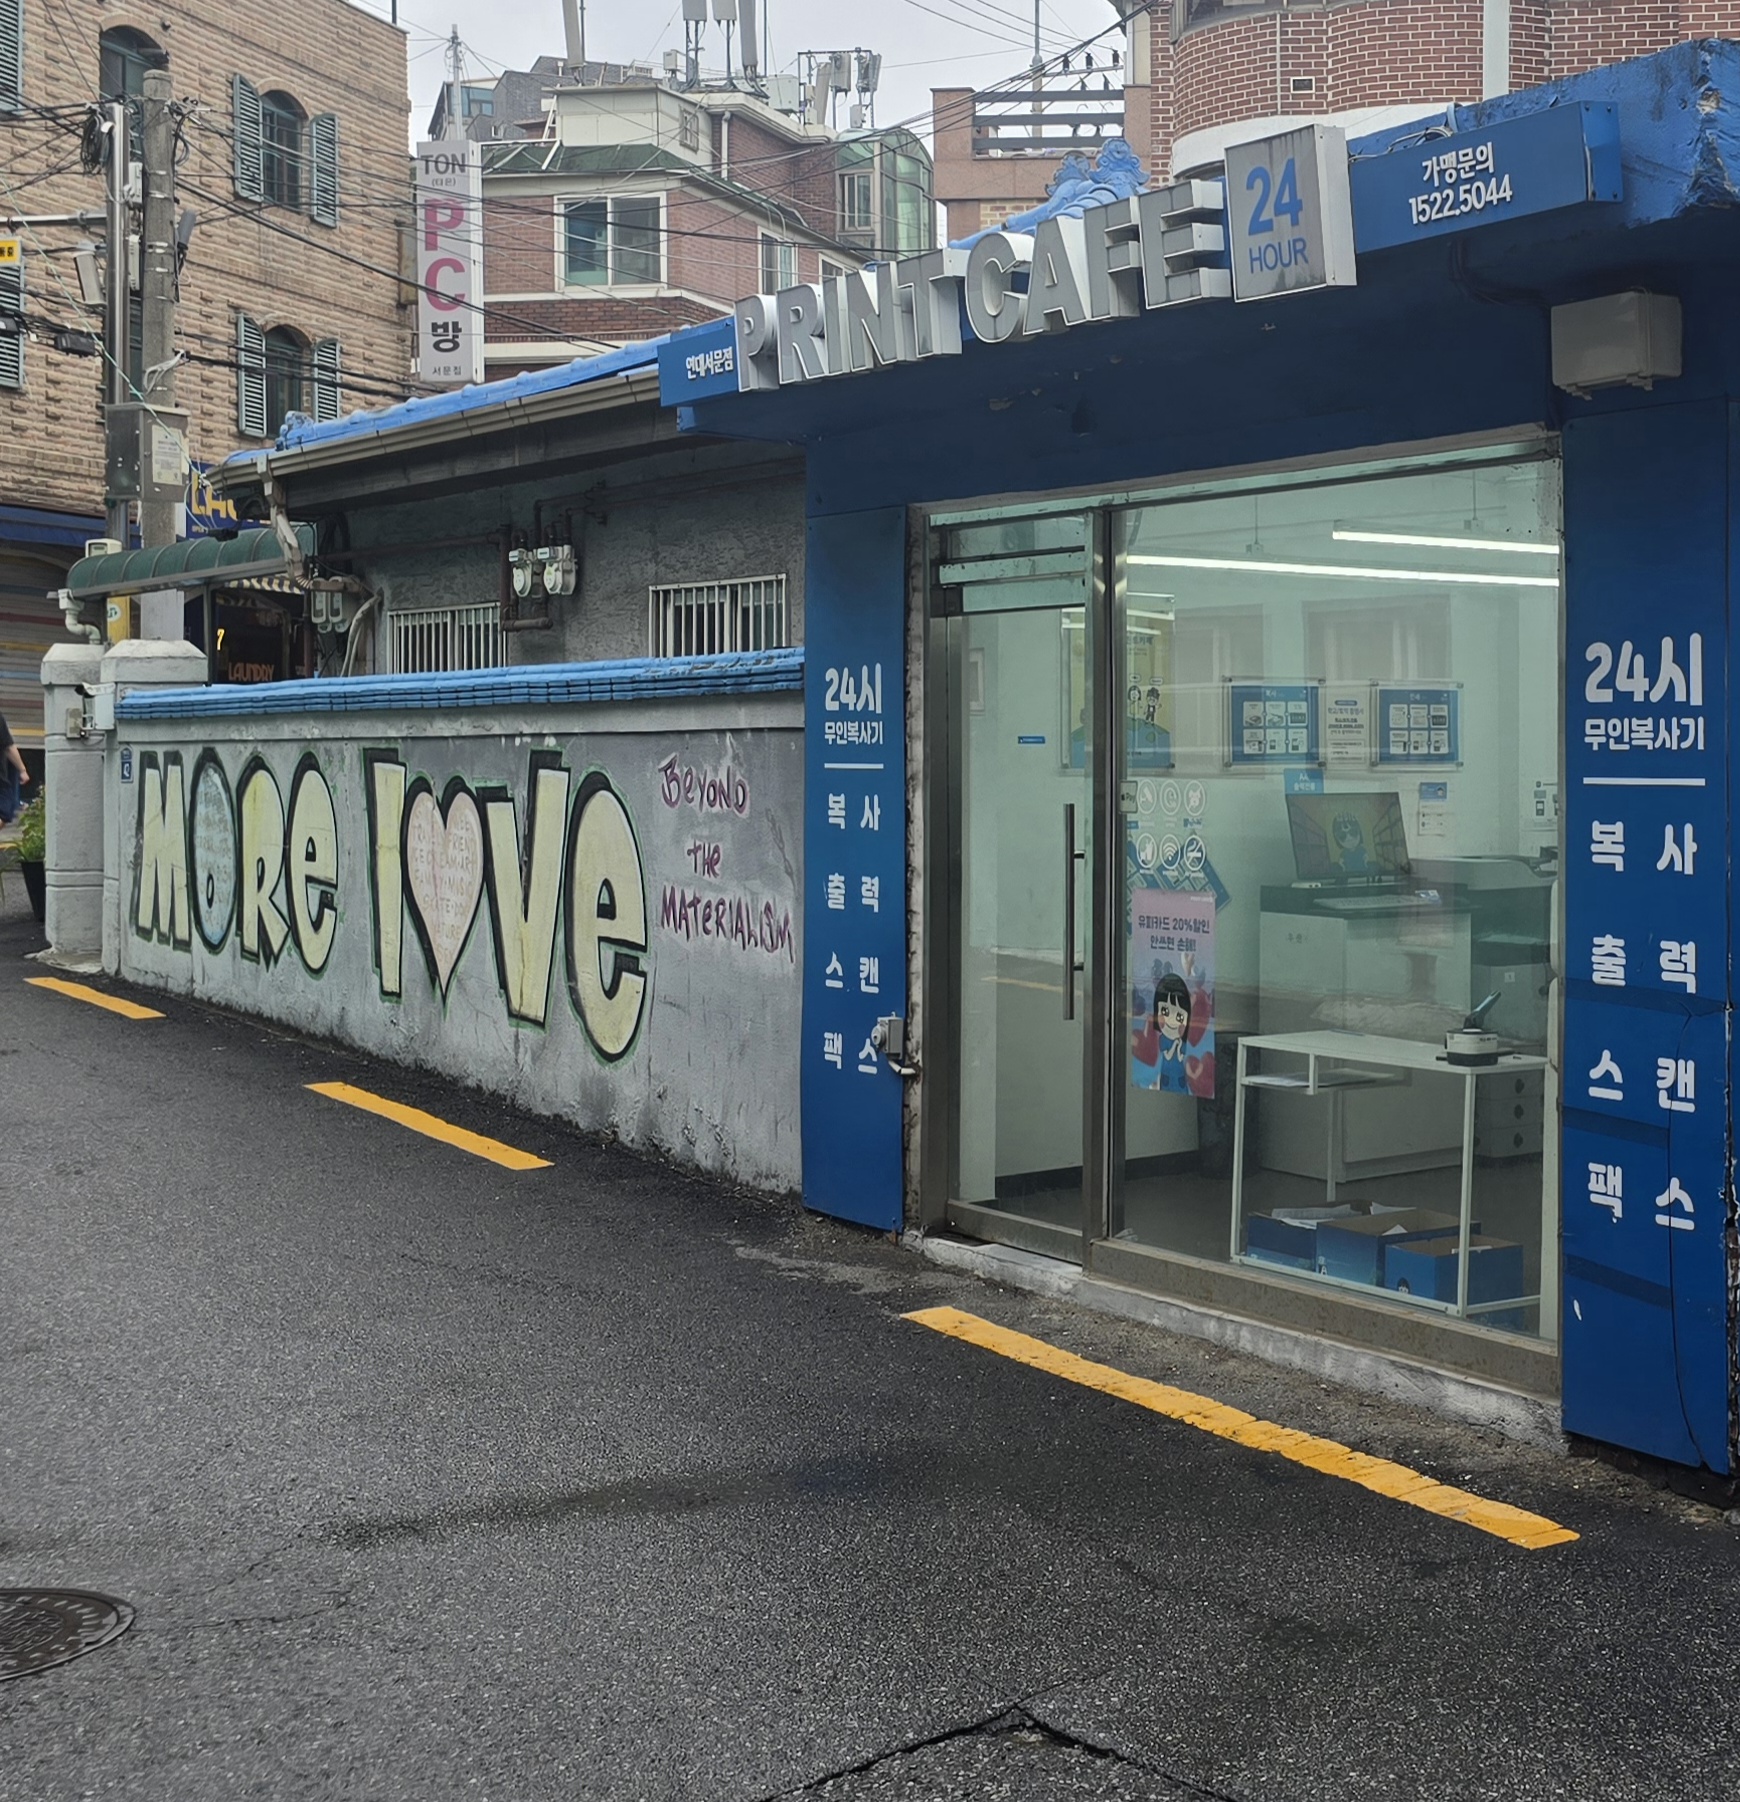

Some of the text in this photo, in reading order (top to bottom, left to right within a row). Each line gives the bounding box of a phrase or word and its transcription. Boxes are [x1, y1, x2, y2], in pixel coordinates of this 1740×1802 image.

[420, 152, 466, 175] TON
[1422, 141, 1495, 188] 가맹문의
[1246, 156, 1304, 236] 24
[1408, 173, 1513, 225] 1522.5044
[1249, 237, 1309, 274] HOUR
[735, 180, 1232, 393] PRINT CAFE
[686, 346, 733, 380] 연대서문점
[228, 661, 276, 682] LAUNDRY
[1585, 633, 1703, 706] 24시
[825, 663, 882, 714] 24시
[824, 720, 884, 746] 무인복사기
[1584, 716, 1705, 752] 무인복사기
[1150, 934, 1175, 950] 안쓰면
